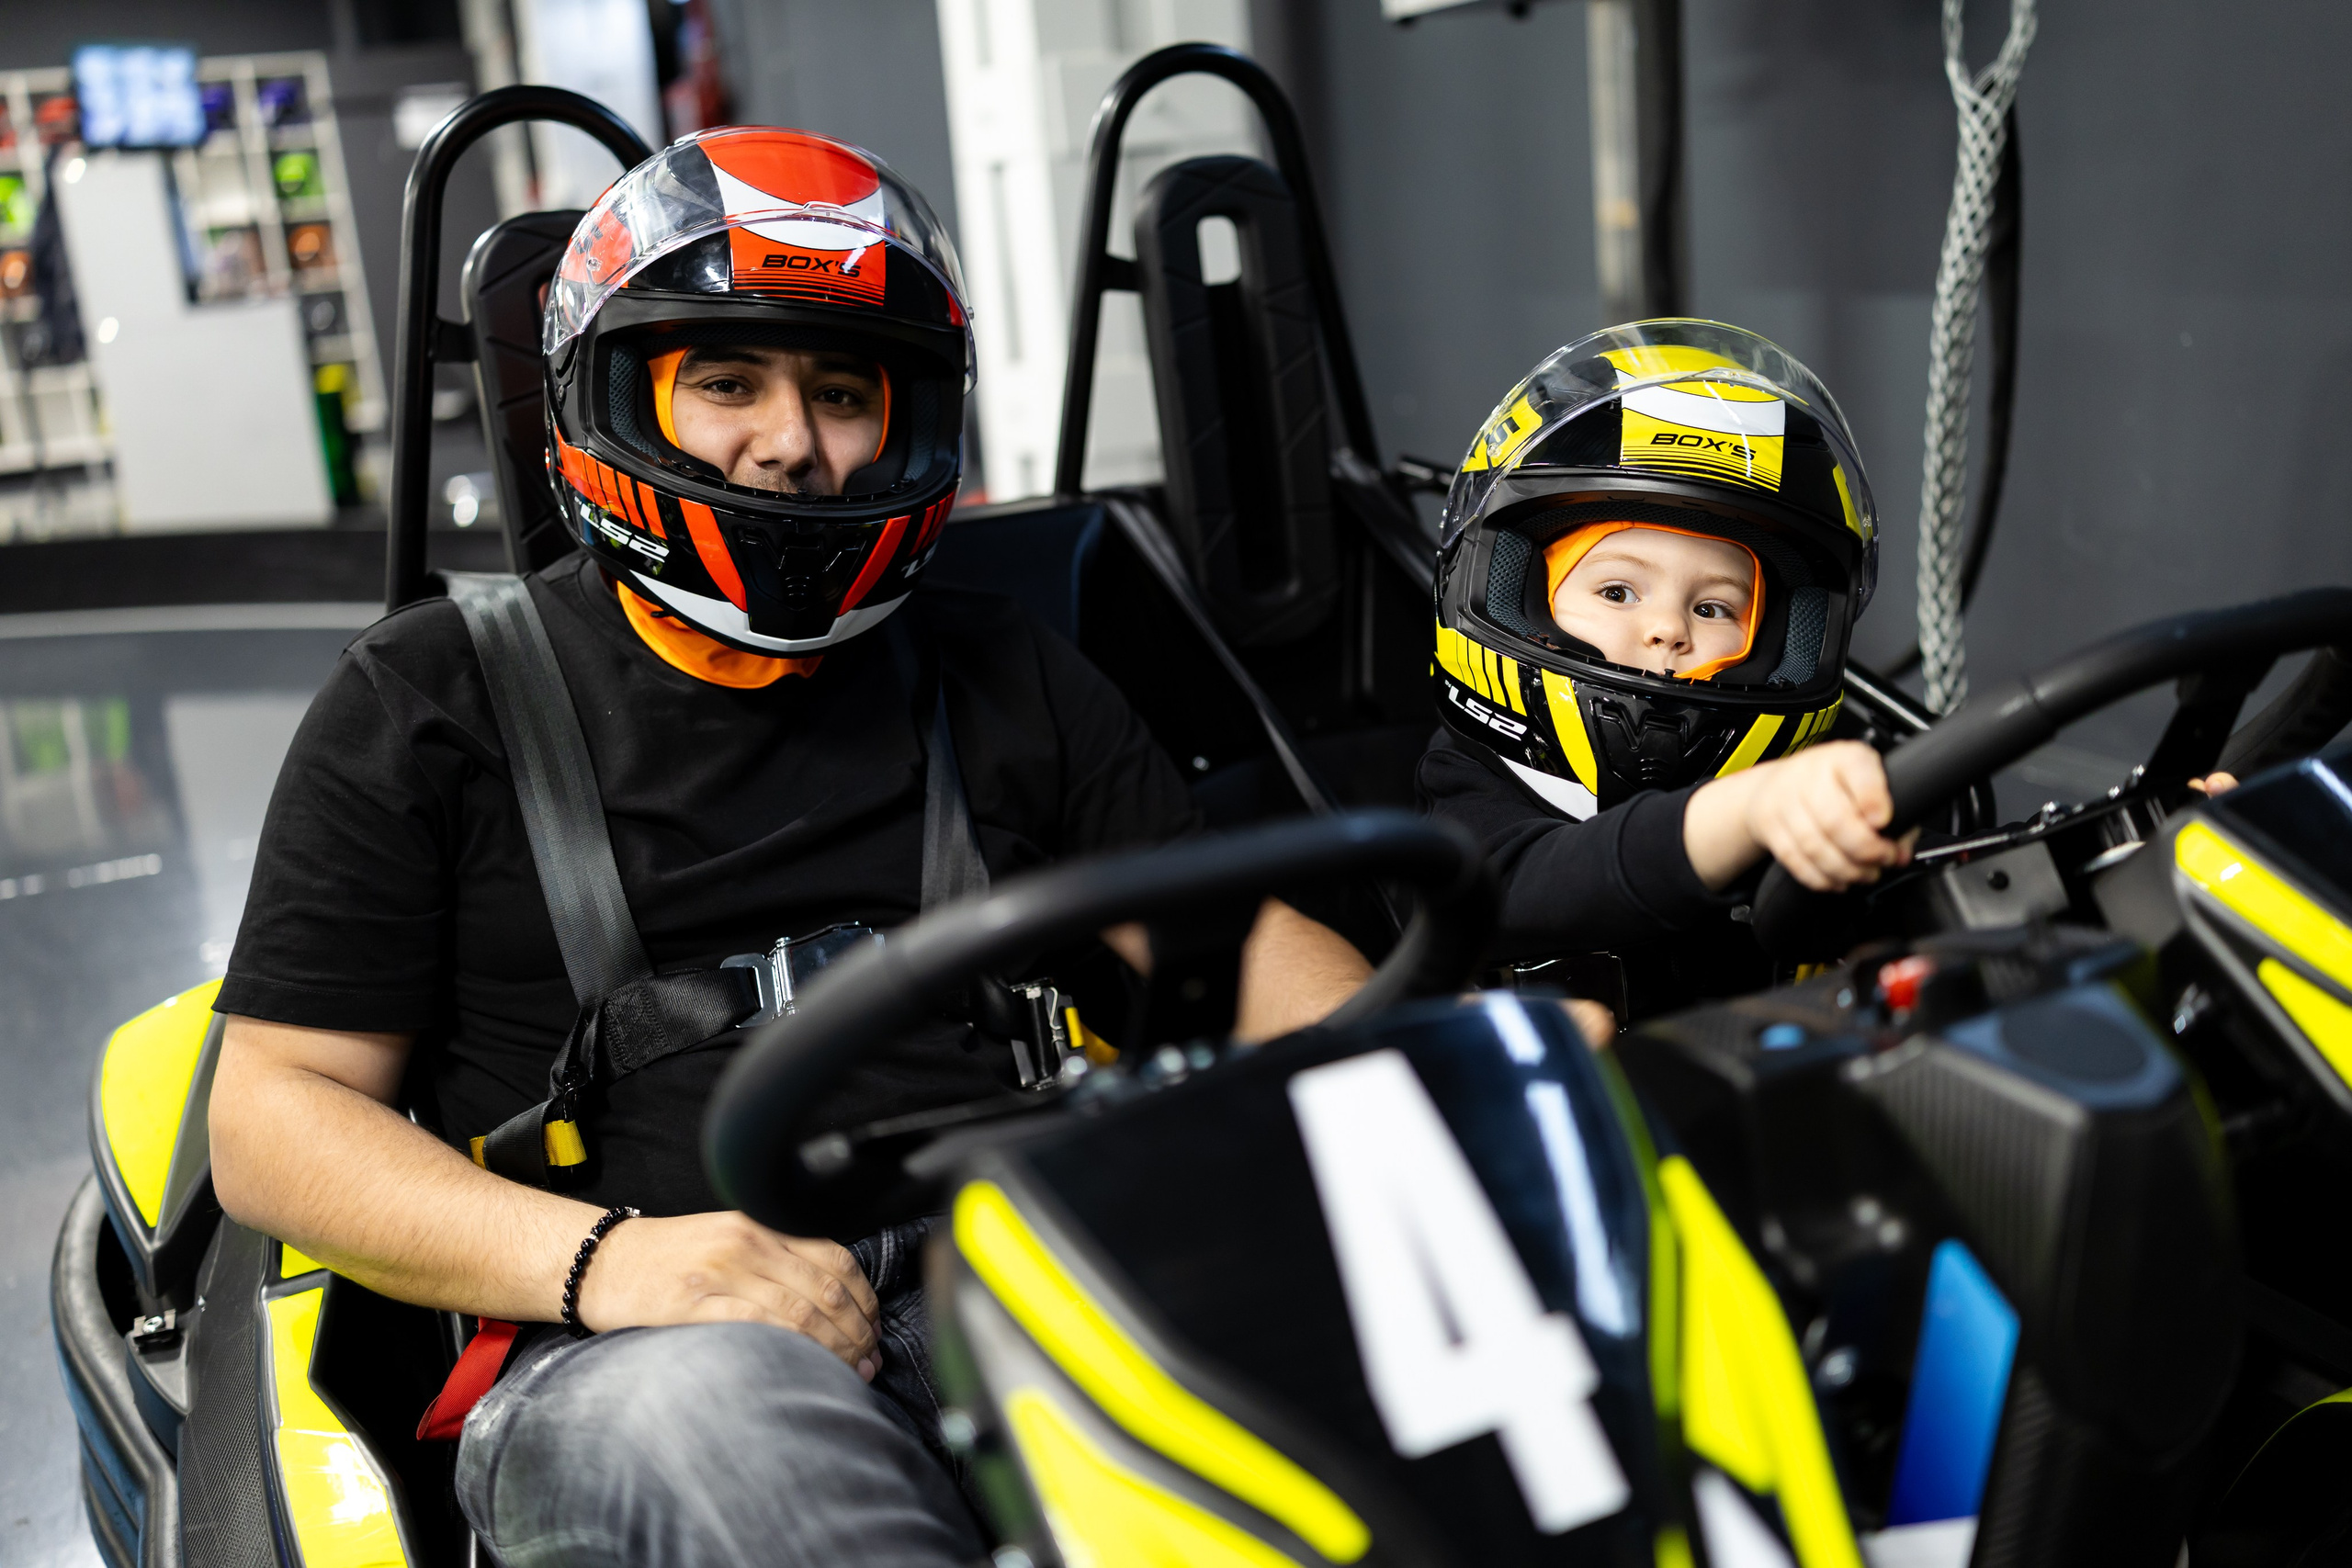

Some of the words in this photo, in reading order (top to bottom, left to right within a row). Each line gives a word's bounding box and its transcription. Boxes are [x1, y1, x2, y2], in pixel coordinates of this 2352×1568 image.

[762, 254, 862, 277] BOX'S
[1650, 433, 1757, 460] BOX'S
[580, 503, 670, 563] LS2
[1449, 685, 1527, 741] LS2
[1290, 1048, 1631, 1534] 4
